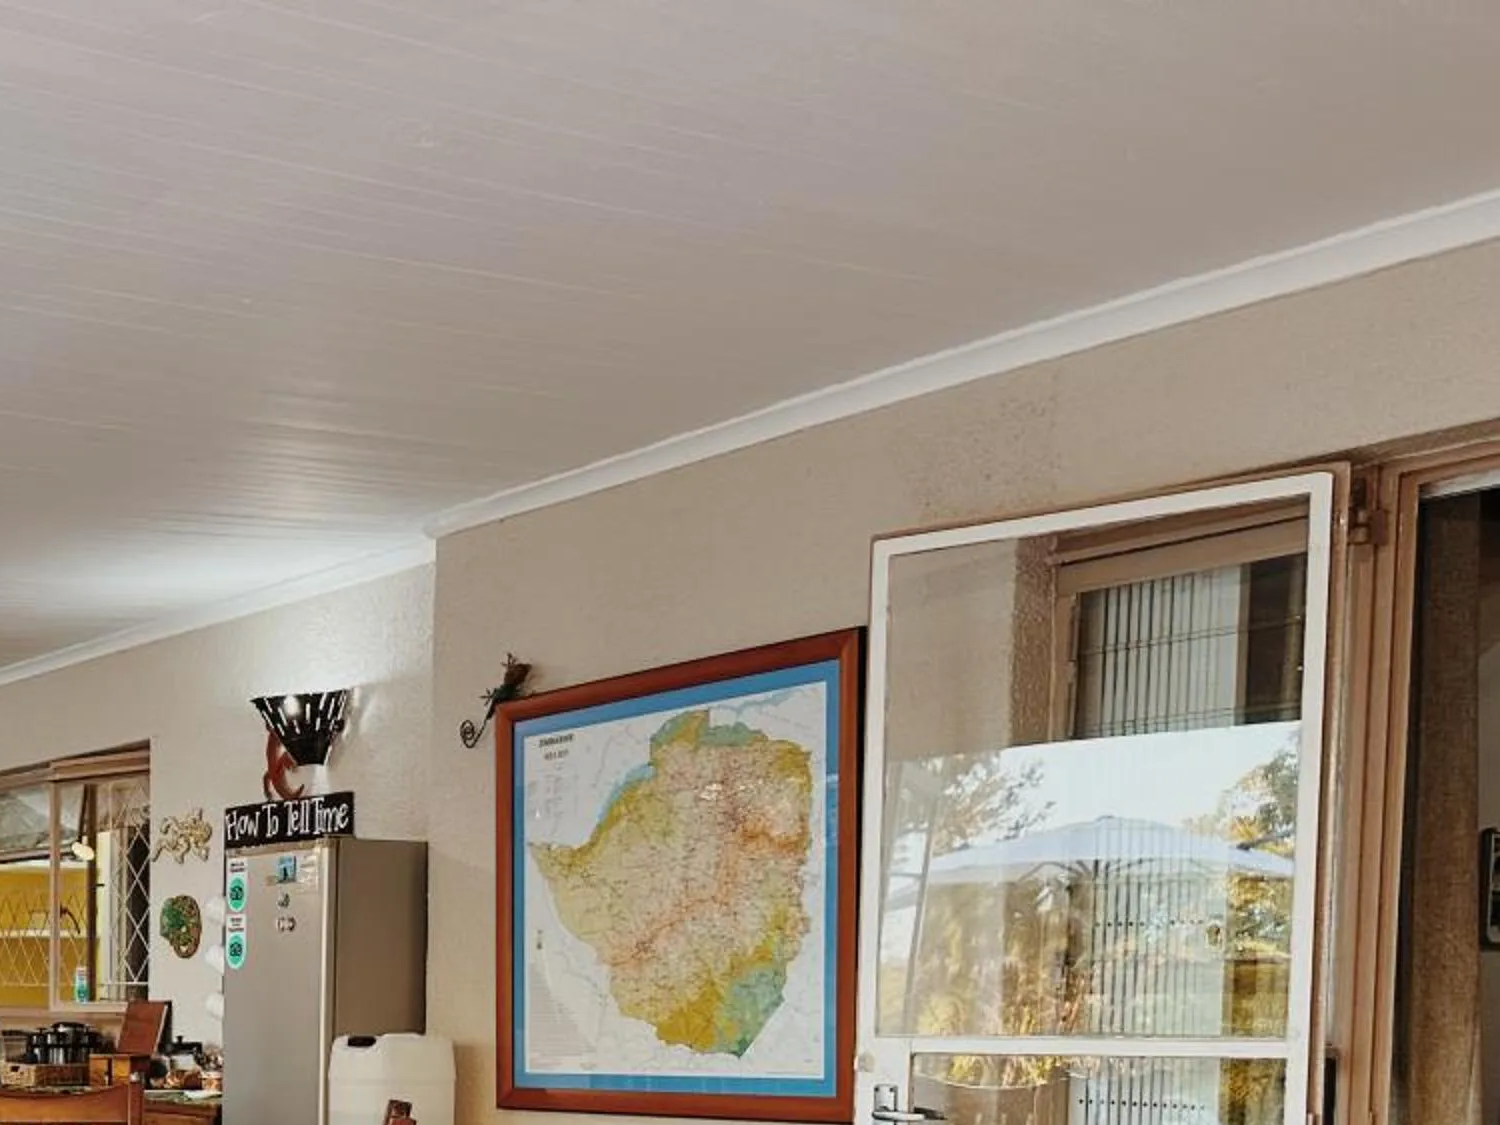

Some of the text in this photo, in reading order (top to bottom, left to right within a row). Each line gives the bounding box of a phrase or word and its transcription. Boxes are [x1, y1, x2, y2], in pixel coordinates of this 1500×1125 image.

[226, 796, 349, 841] How To Tell Time
